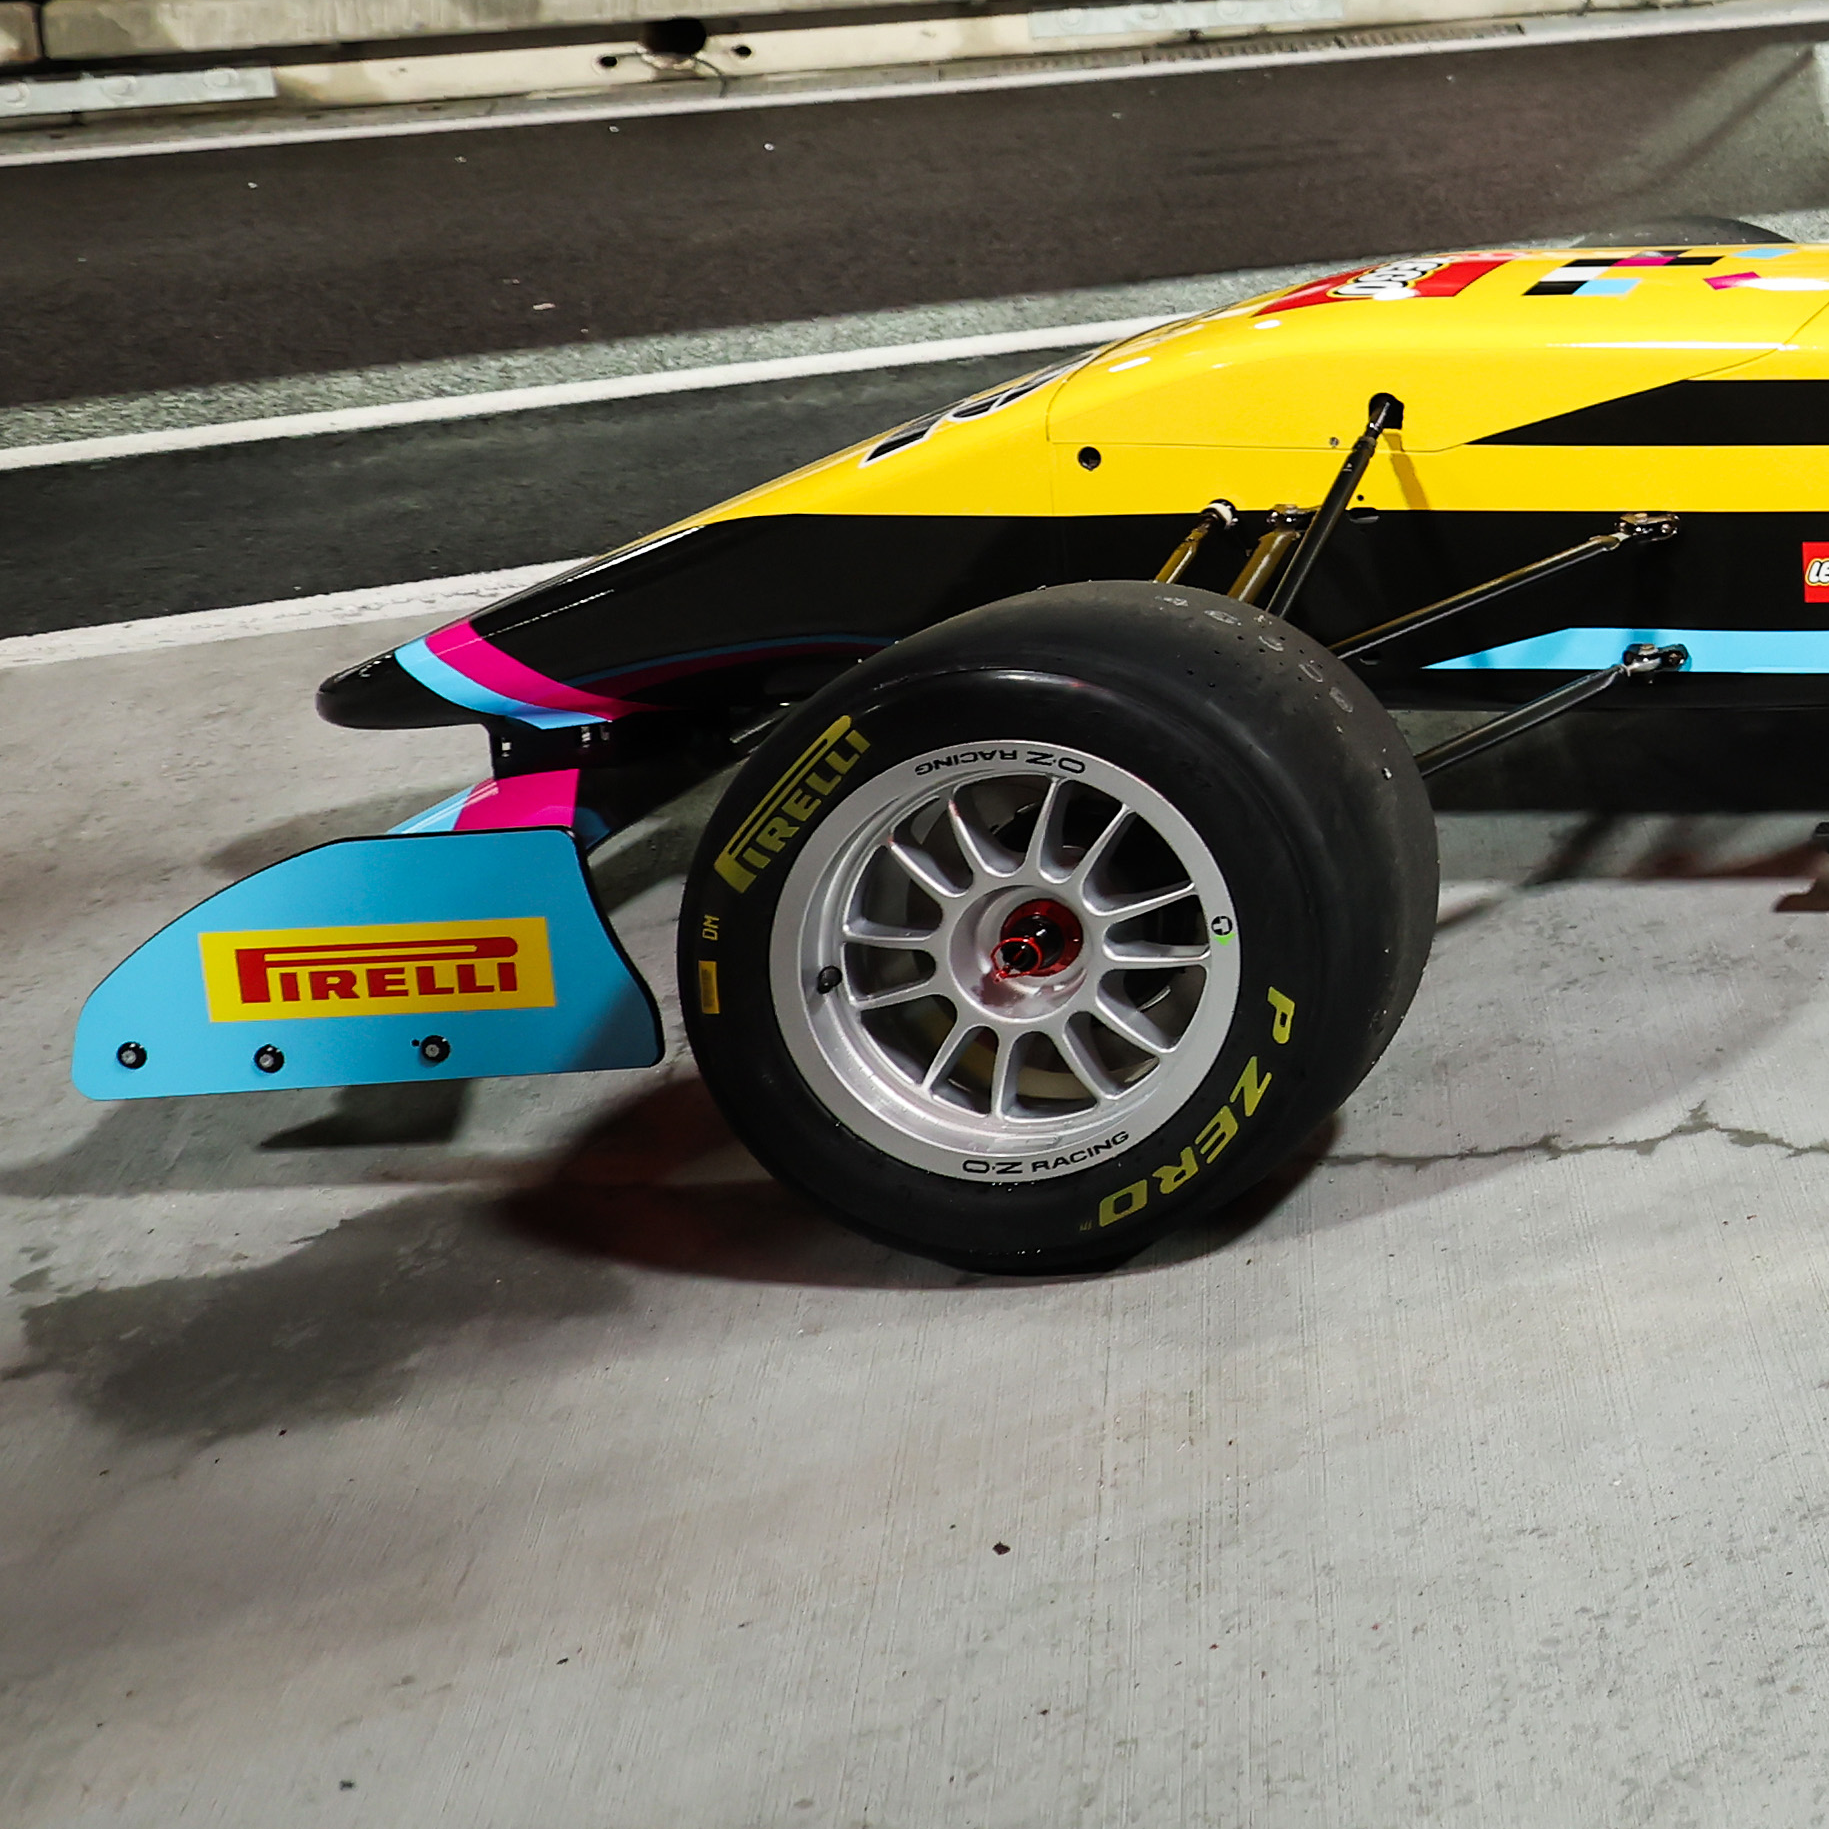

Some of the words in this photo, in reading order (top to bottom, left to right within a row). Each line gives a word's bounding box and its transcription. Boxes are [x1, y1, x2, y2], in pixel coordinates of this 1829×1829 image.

[914, 749, 1018, 776] RACING
[714, 714, 871, 894] PIRELLI
[702, 914, 721, 942] DM
[235, 936, 519, 1004] PIRELLI
[1265, 986, 1297, 1045] P
[1030, 1130, 1130, 1174] RACING
[1097, 1070, 1276, 1228] ZERO
